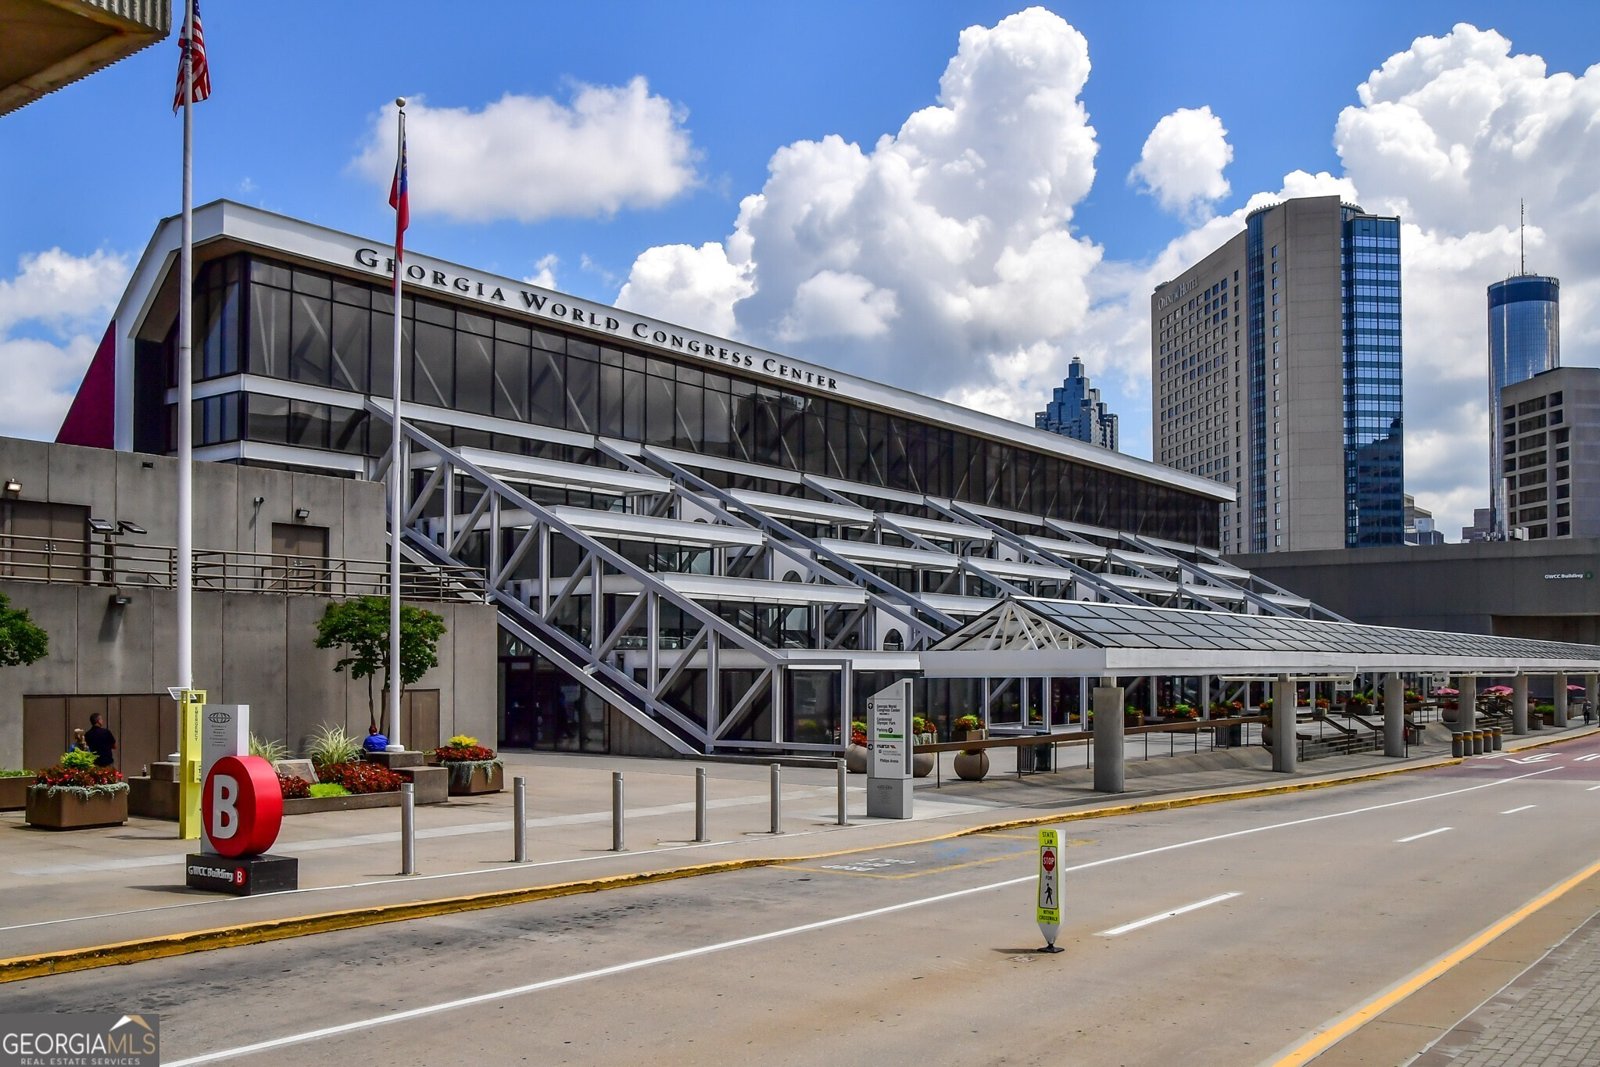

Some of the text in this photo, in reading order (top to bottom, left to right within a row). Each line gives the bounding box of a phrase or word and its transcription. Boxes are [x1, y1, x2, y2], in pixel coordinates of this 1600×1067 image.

[355, 248, 838, 390] GEORGIA WORLD CONGRESS CENTER
[212, 774, 240, 840] B
[188, 865, 243, 883] GWCC Building B
[1043, 857, 1055, 865] STOP
